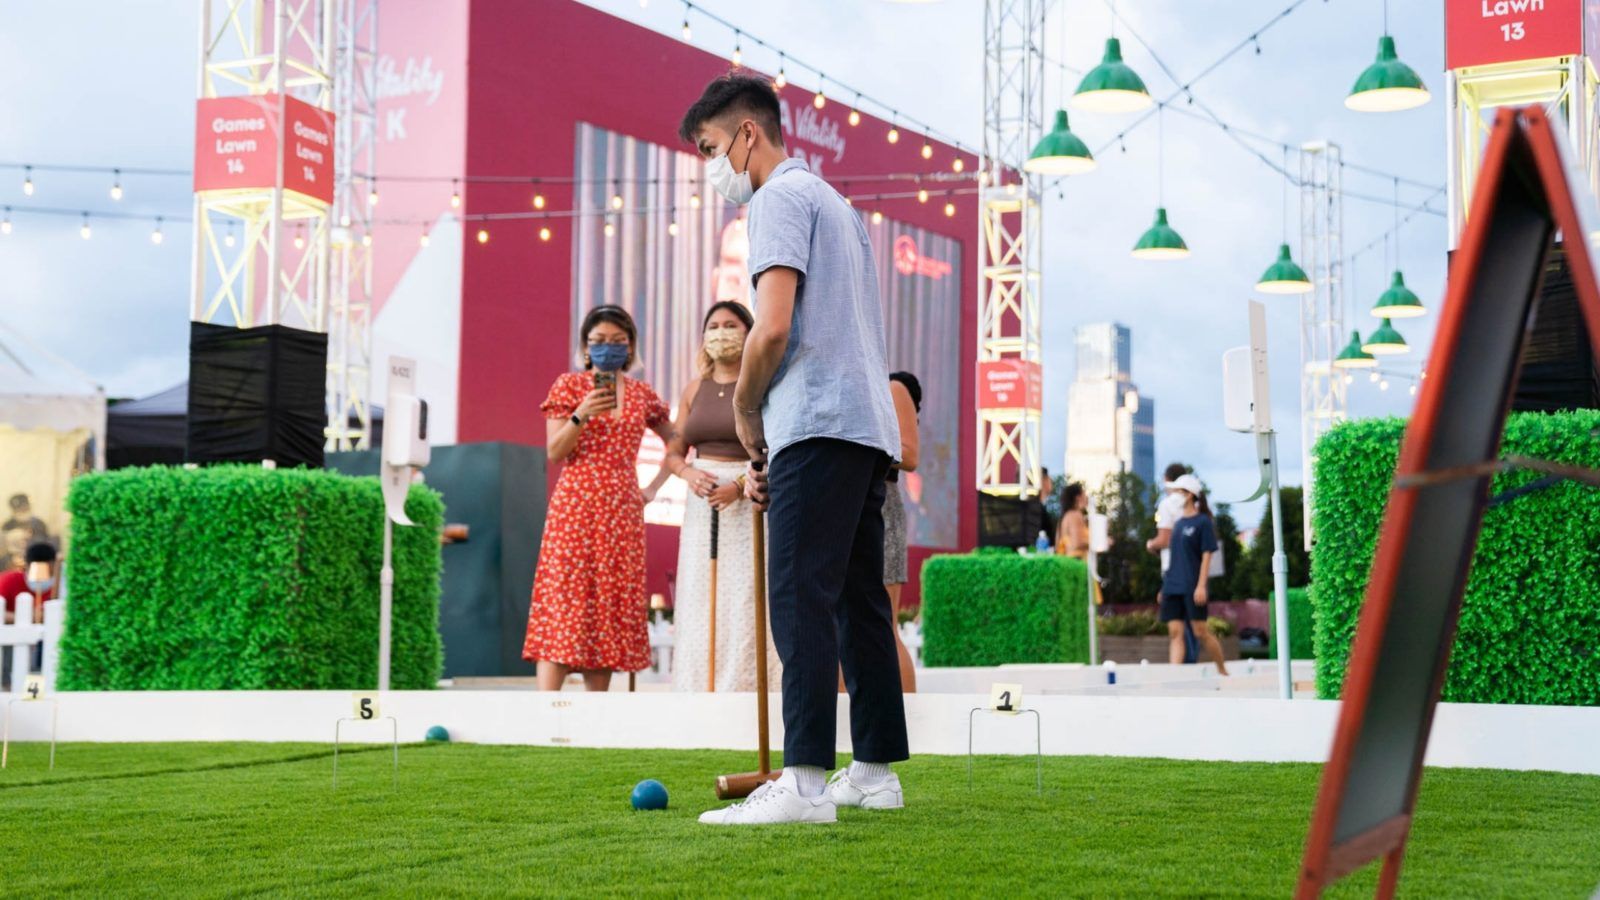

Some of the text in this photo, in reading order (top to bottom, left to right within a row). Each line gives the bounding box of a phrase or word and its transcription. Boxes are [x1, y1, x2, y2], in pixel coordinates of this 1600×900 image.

[1481, 0, 1544, 18] Lawn
[1500, 21, 1526, 42] 13
[212, 118, 265, 134] Games
[293, 120, 329, 146] Games
[215, 138, 257, 154] Lawn
[296, 142, 324, 165] Lawn
[226, 158, 245, 174] 14
[303, 165, 316, 182] 14
[27, 682, 39, 699] 4
[360, 698, 373, 720] 5
[996, 690, 1013, 711] 1
